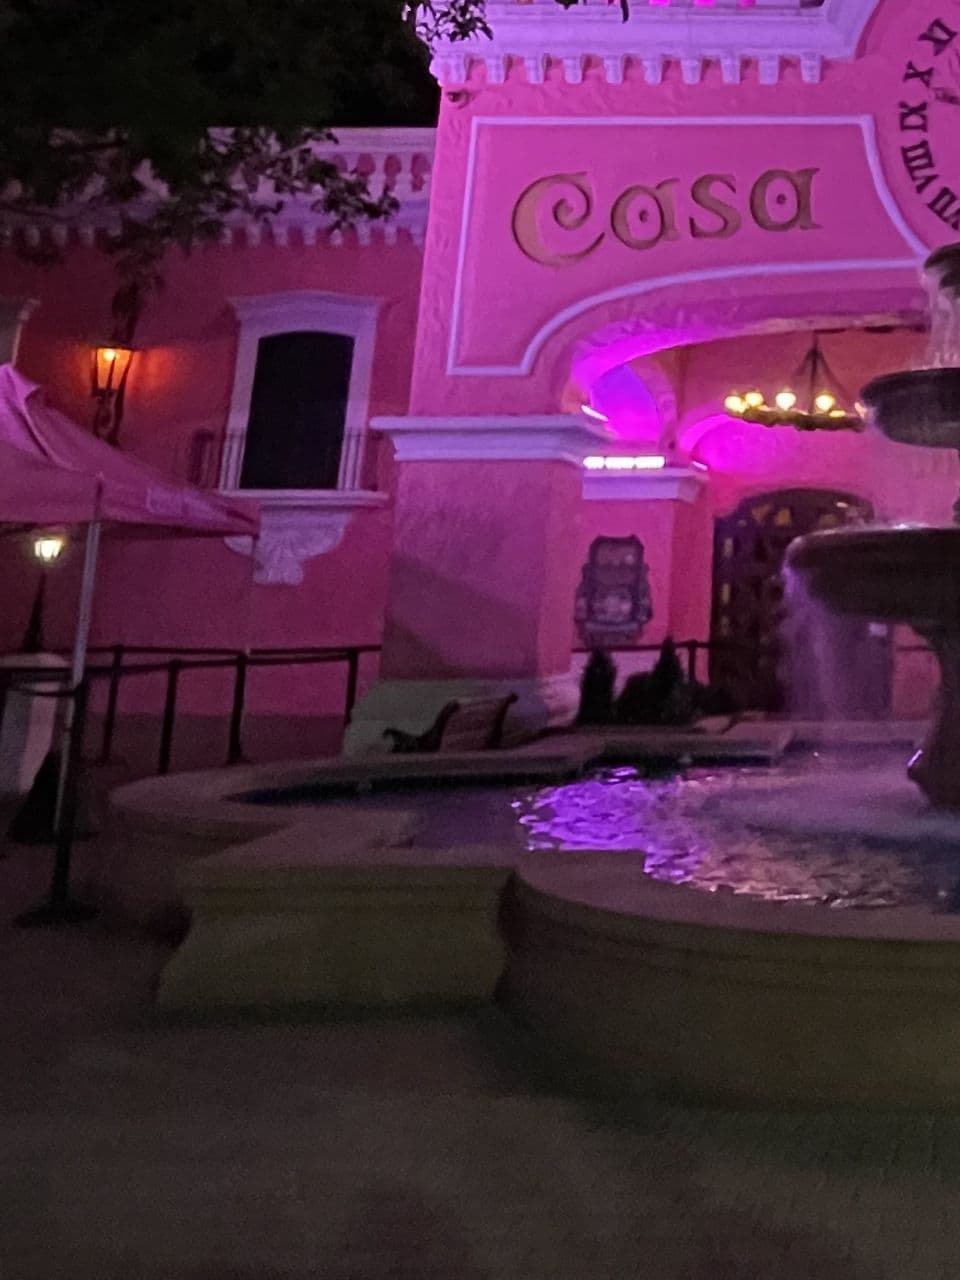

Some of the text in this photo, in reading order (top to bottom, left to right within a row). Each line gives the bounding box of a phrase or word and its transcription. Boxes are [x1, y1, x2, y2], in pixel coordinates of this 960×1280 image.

[918, 18, 957, 56] XI
[903, 61, 934, 88] X
[511, 167, 824, 268] Casa
